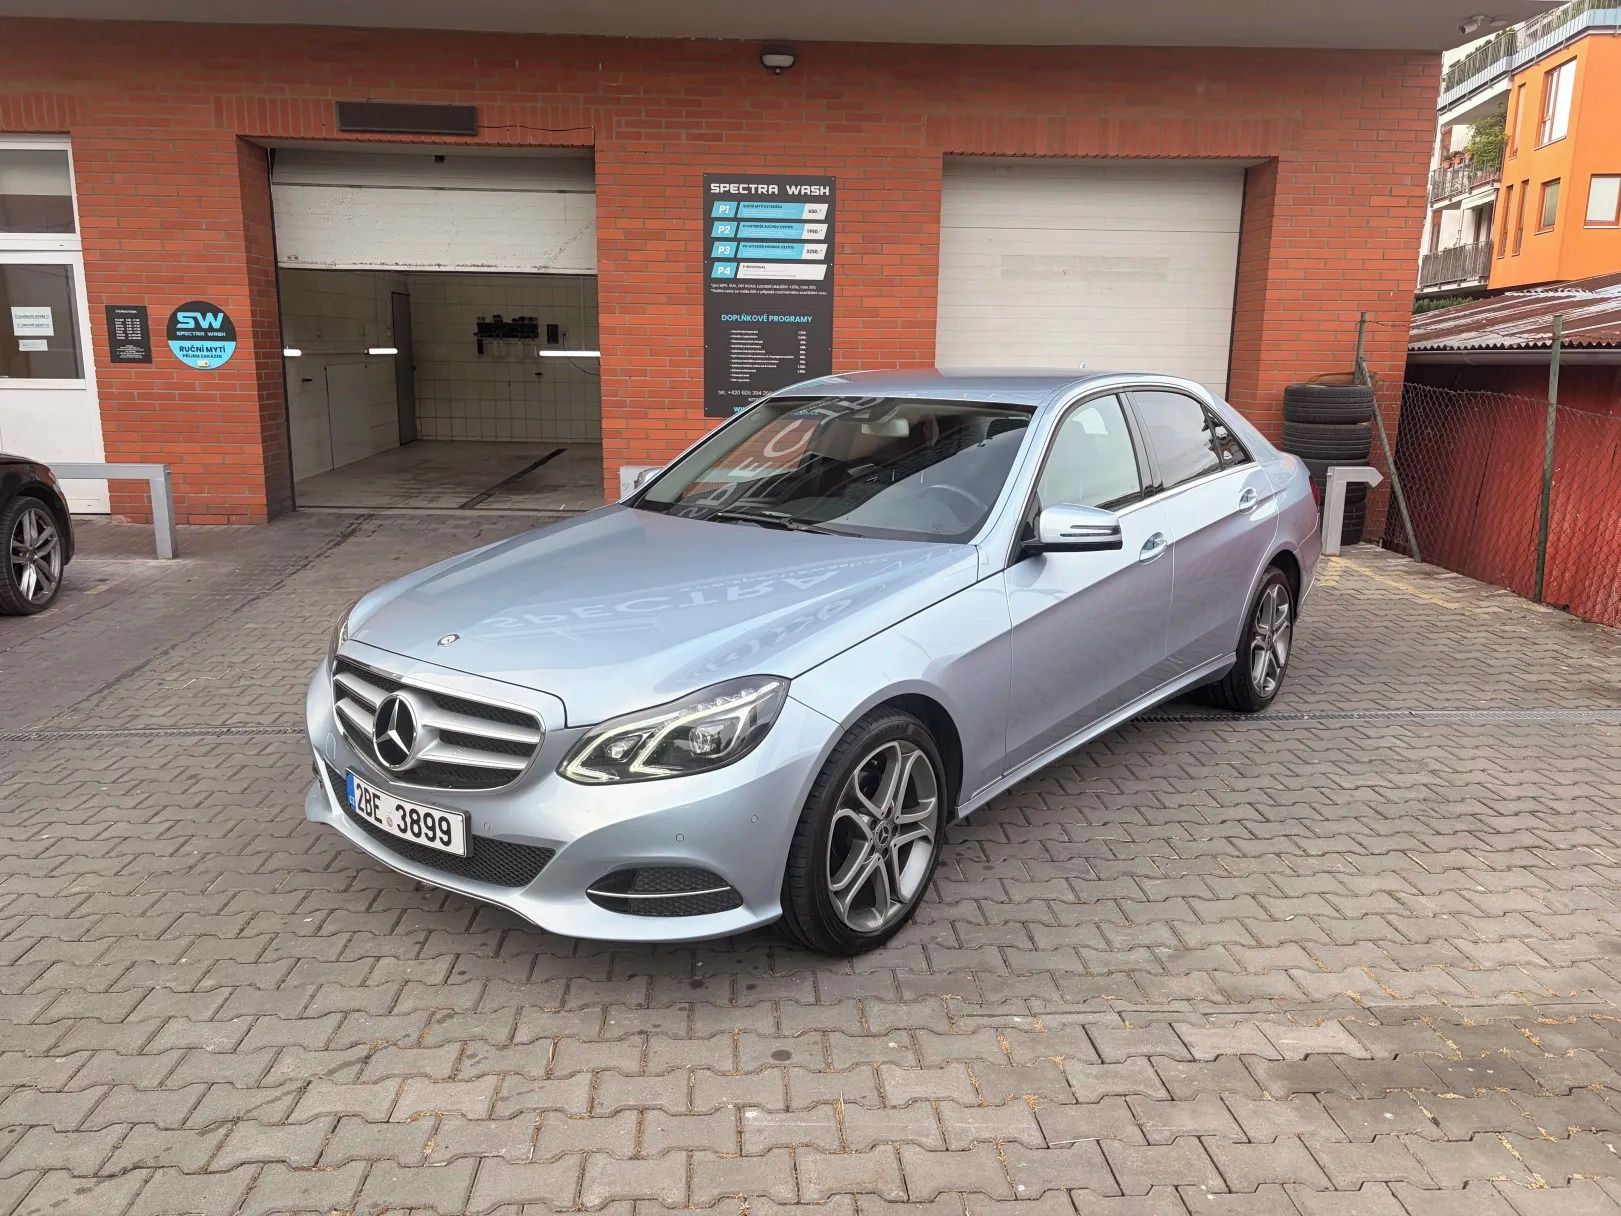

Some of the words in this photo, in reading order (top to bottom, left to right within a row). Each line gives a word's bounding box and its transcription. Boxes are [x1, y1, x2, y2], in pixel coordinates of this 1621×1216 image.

[710, 183, 779, 195] SPECTRA
[786, 184, 830, 196] WASH
[719, 205, 730, 214] P1
[718, 225, 731, 234] P2
[718, 246, 731, 255] P3
[717, 266, 731, 275] P4
[176, 311, 224, 329] SW
[721, 313, 768, 322] DOPLŇKOVÉ
[768, 315, 813, 323] PROGRAMY
[179, 344, 205, 353] RUČNÍ
[205, 344, 226, 353] MYTÍ
[356, 782, 383, 825] 2BE
[395, 804, 452, 847] 3899
